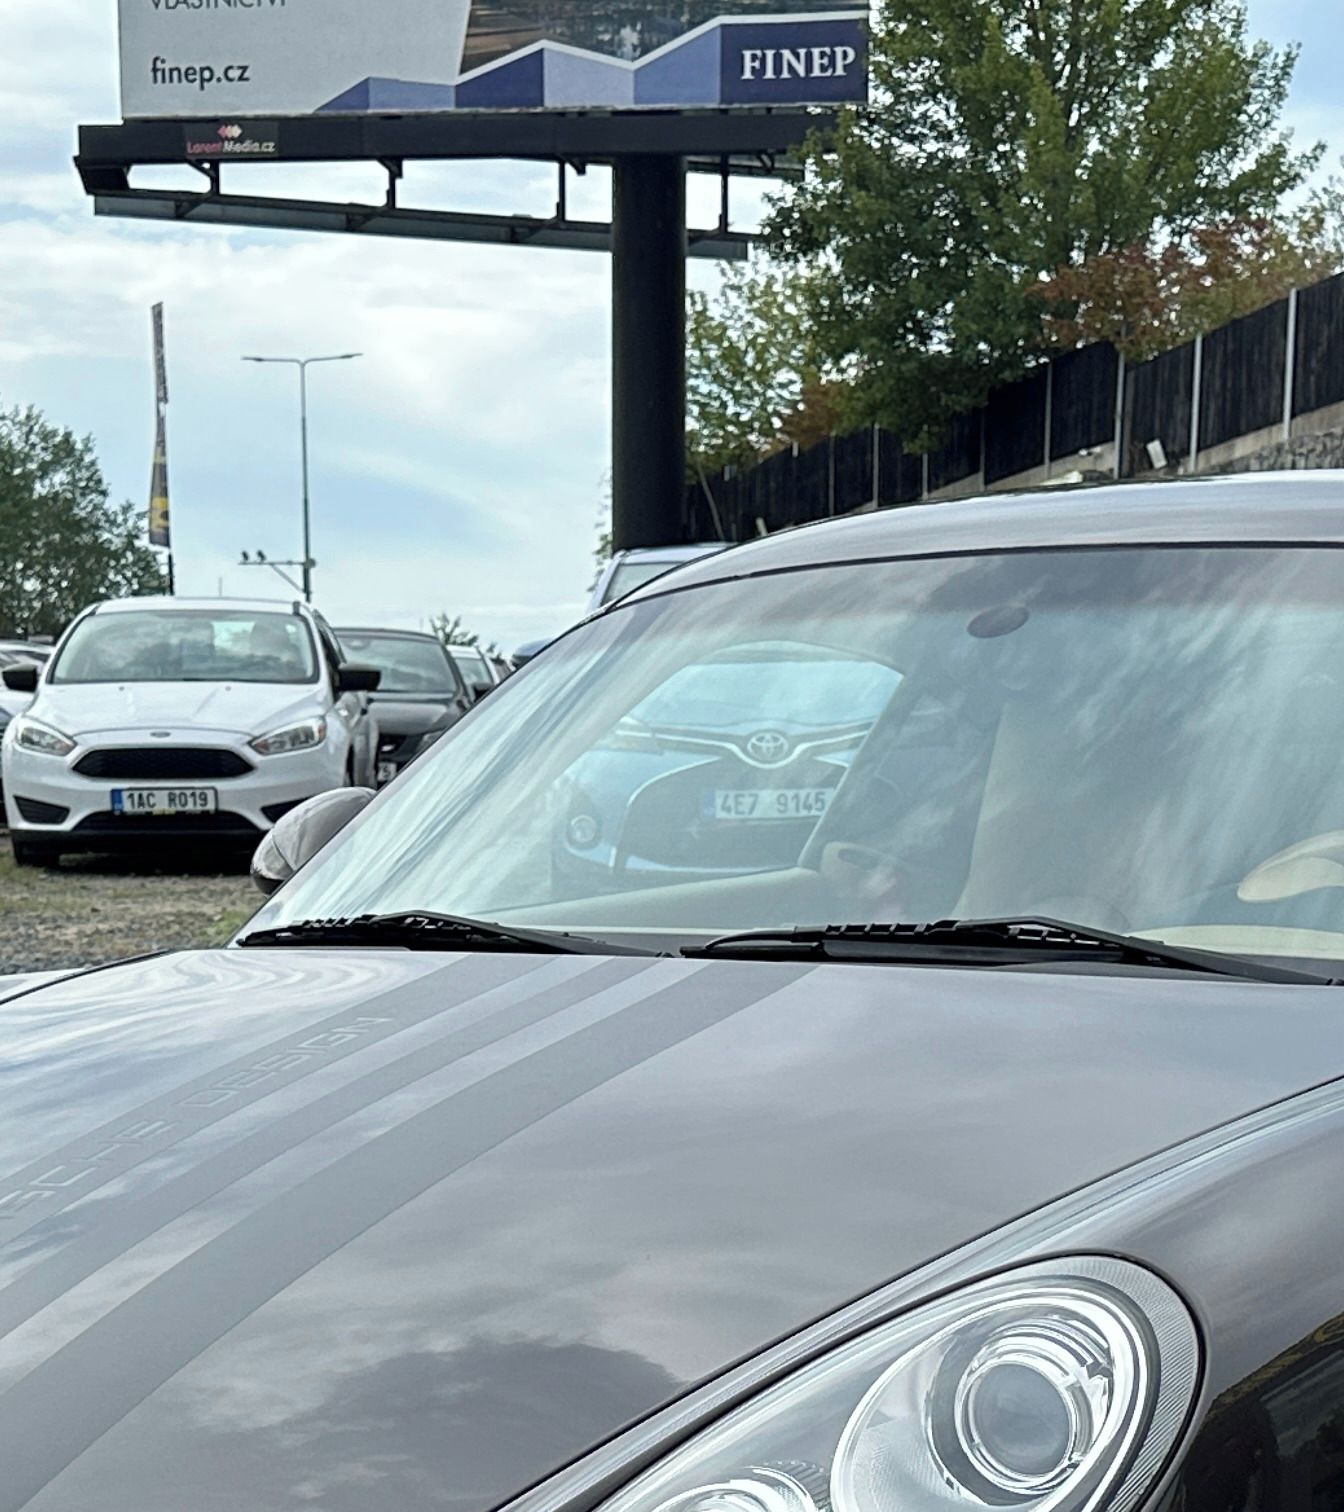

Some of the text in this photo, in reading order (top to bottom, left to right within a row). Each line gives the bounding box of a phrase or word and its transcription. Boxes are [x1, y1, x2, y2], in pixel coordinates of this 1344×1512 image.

[152, 56, 251, 91] finep.cz
[741, 46, 856, 80] FINEP
[127, 792, 157, 809] 1AC
[719, 791, 826, 815] 4E7 9145
